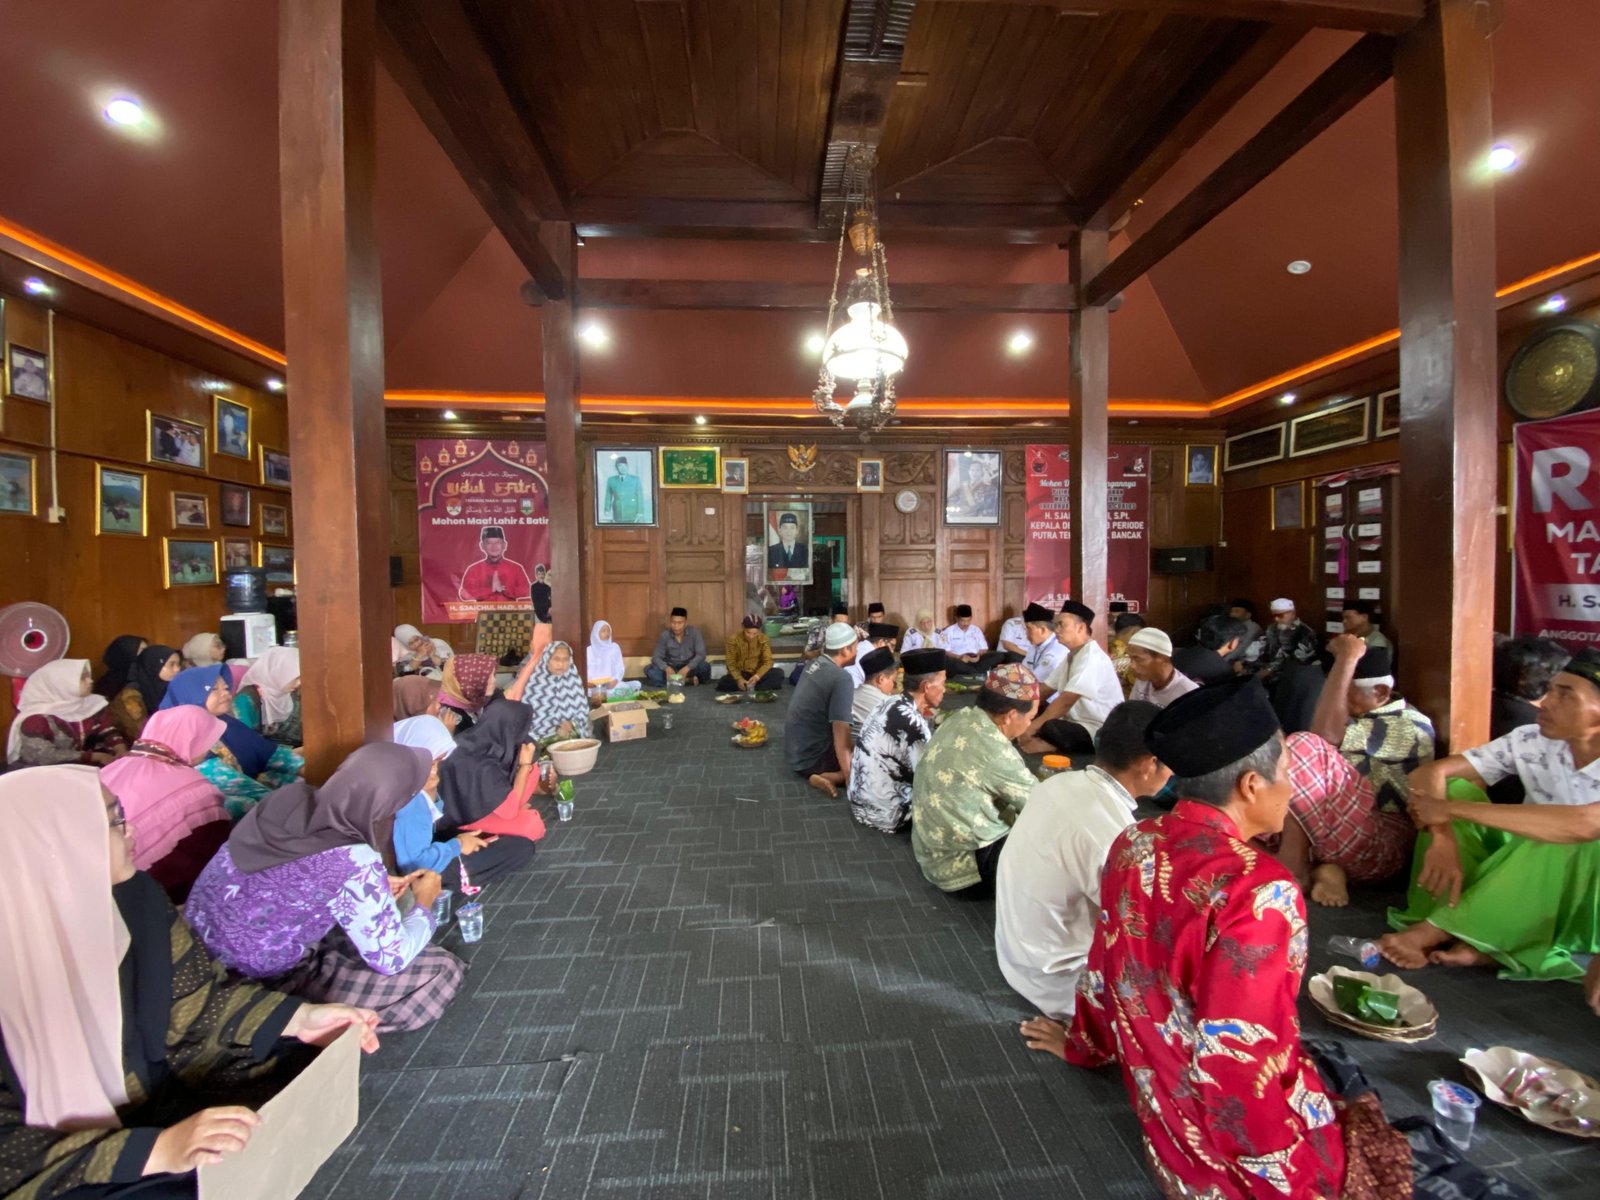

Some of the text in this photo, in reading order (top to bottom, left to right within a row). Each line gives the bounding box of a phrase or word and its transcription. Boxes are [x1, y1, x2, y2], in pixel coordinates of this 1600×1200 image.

[432, 517, 466, 525] Mohon
[467, 517, 493, 525] Maaf
[493, 516, 518, 525] Lahir
[518, 517, 525, 525] &
[1030, 521, 1061, 530] KEPALA
[1112, 521, 1144, 530] PERIODE
[1032, 531, 1057, 540] PUTRA
[1111, 531, 1142, 540] BANCAK
[1558, 594, 1576, 608] H.
